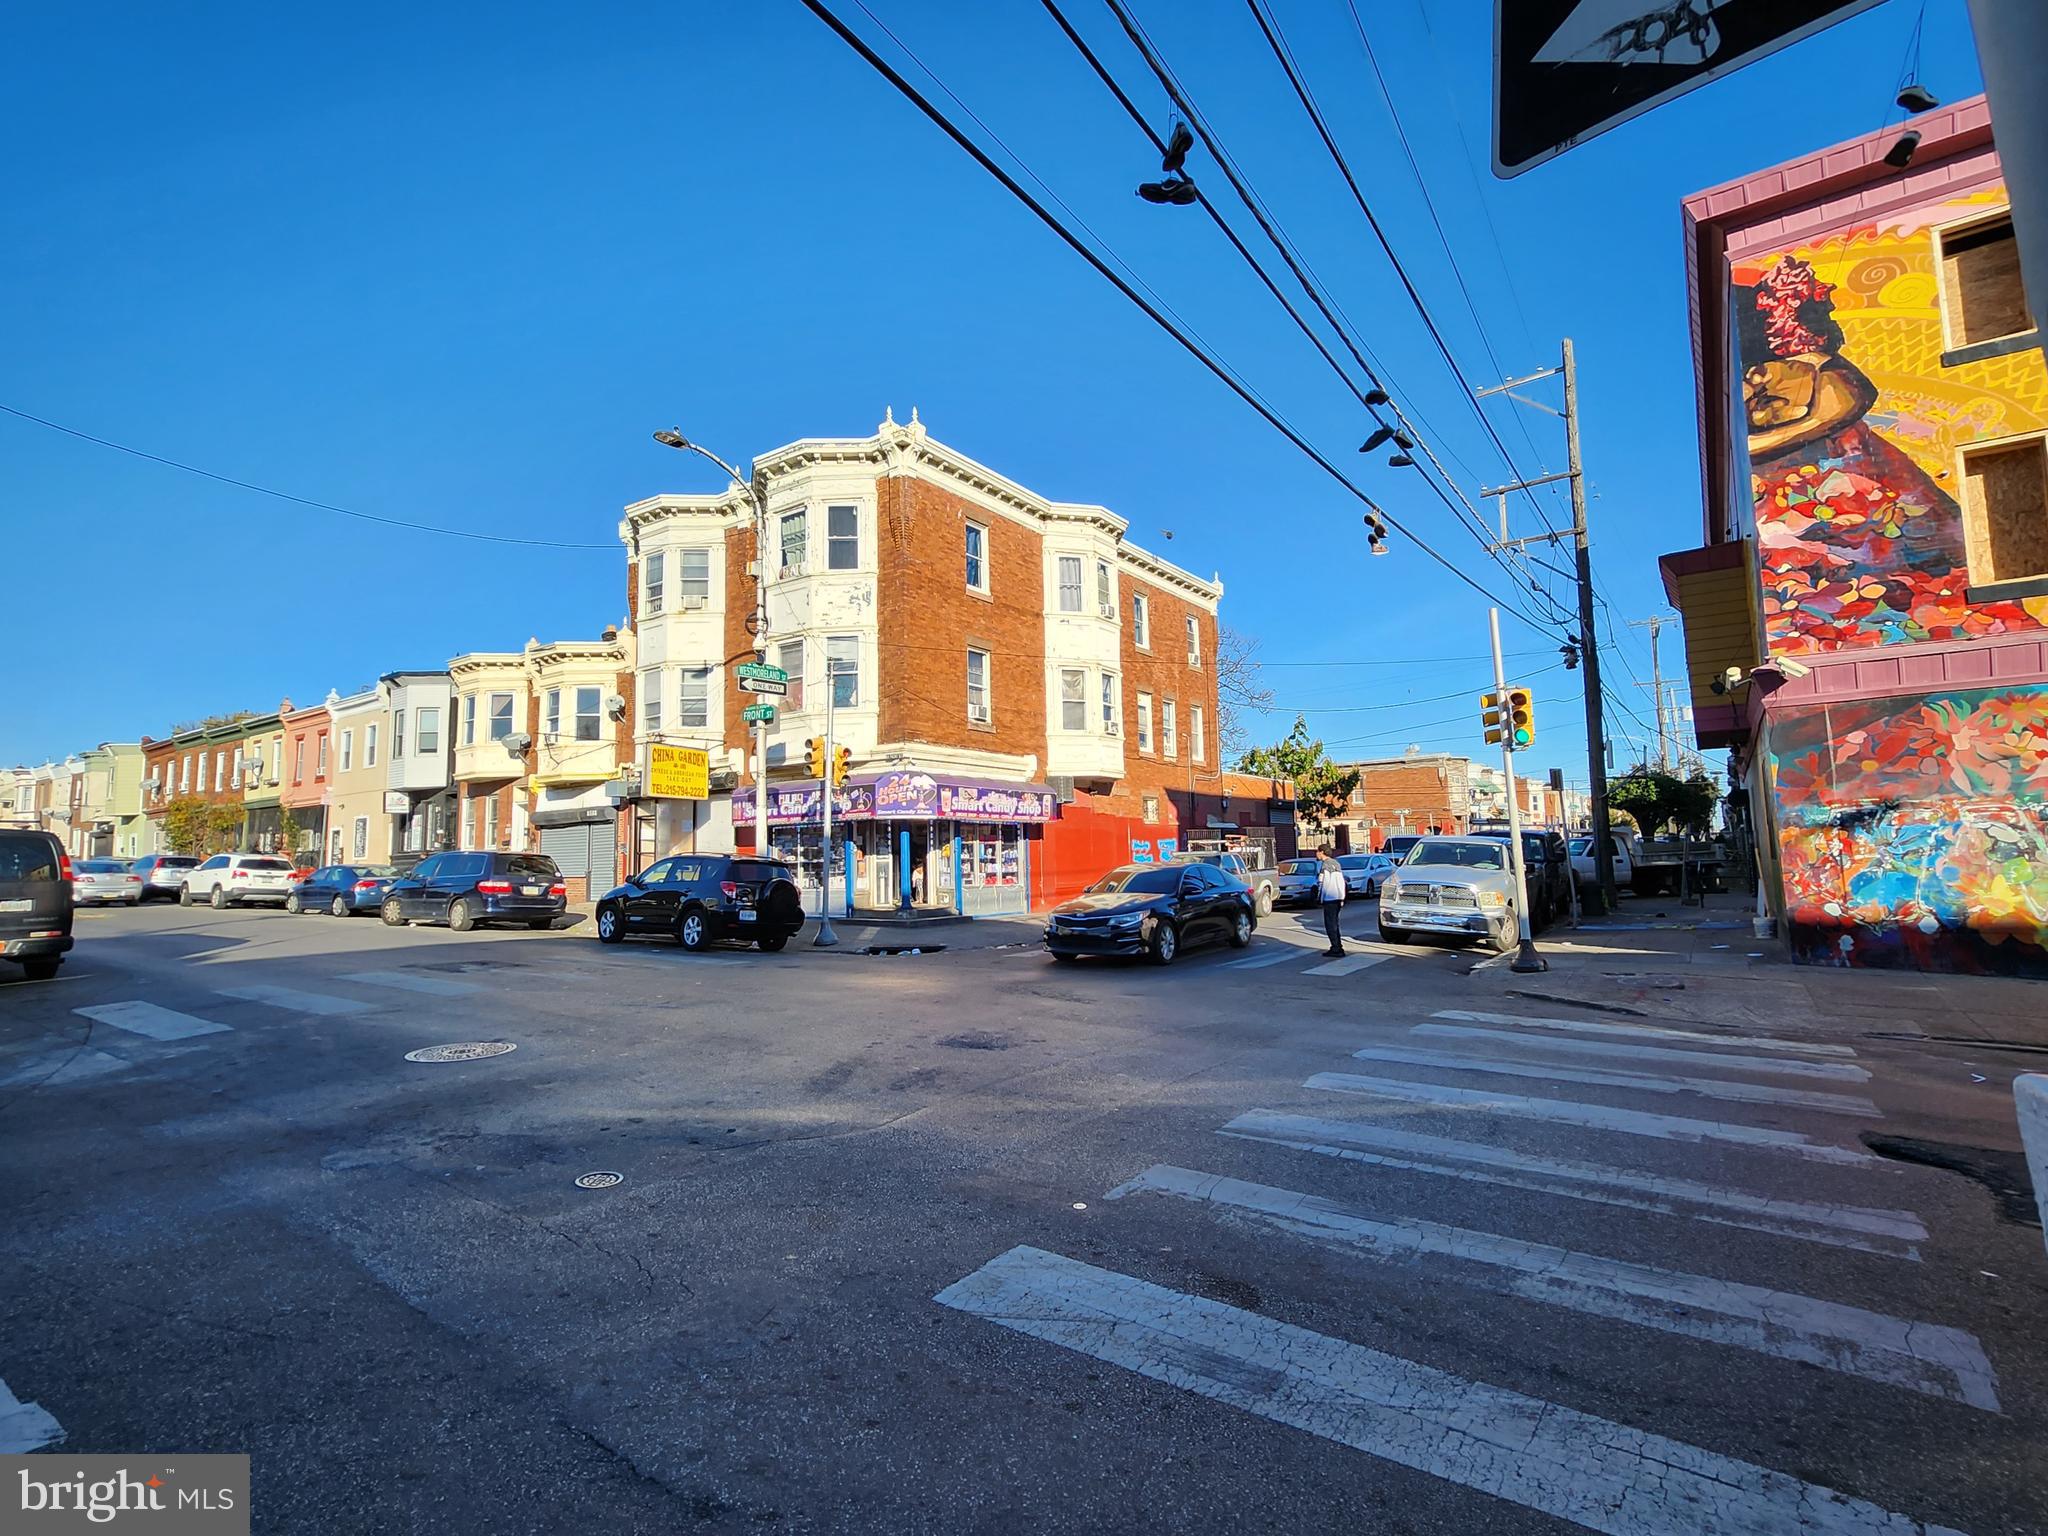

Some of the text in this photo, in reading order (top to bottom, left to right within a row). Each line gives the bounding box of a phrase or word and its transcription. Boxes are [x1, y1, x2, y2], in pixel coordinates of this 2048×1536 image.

[739, 666, 781, 680] WESTMORELAND
[743, 709, 765, 720] FRONT
[652, 748, 674, 763] CHINA
[678, 751, 706, 767] GARDEN
[888, 774, 910, 788] 24
[877, 790, 918, 805] OPEN
[951, 796, 984, 812] Smart
[985, 798, 1017, 816] Candy
[1017, 799, 1041, 816] Shop
